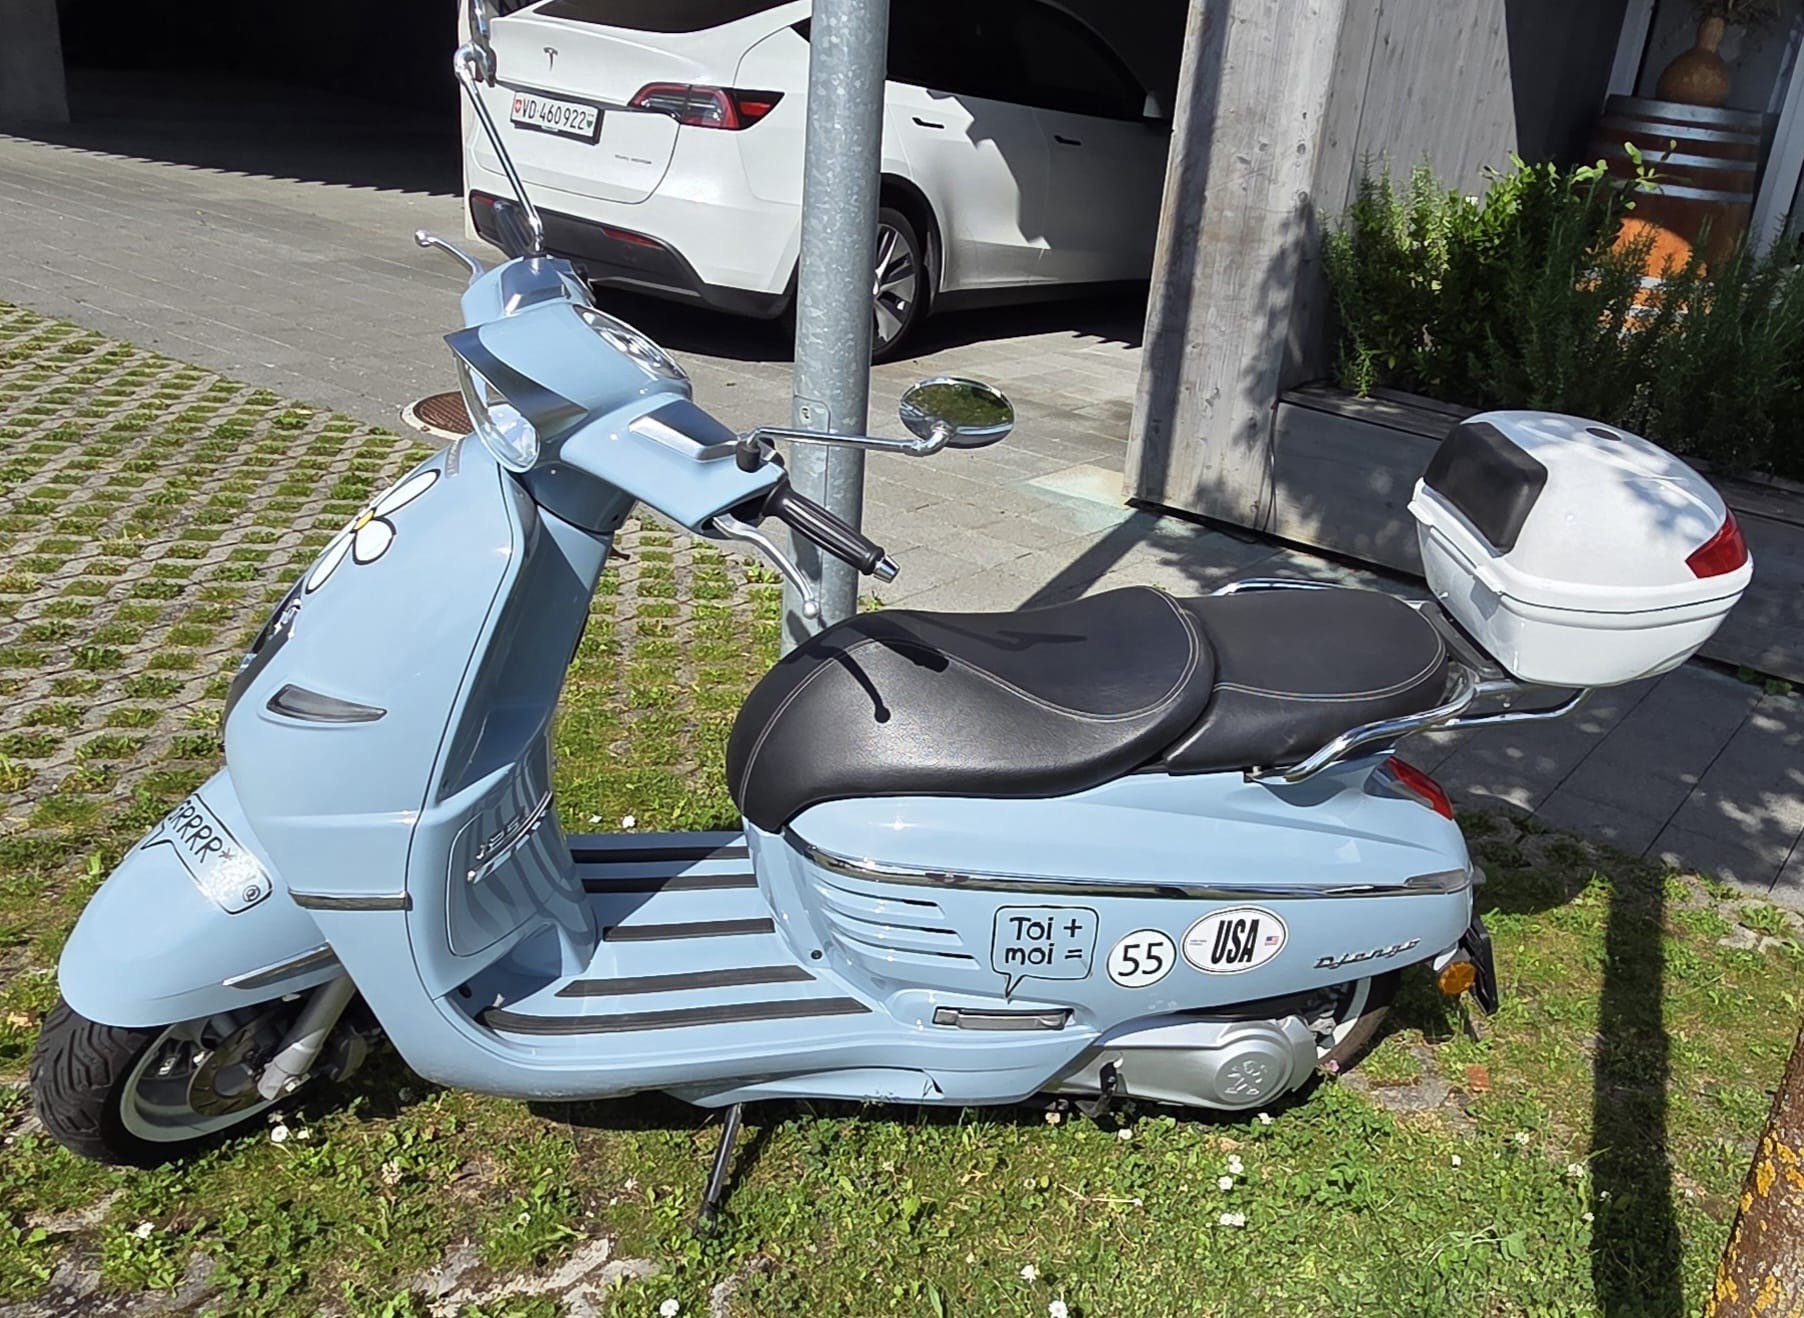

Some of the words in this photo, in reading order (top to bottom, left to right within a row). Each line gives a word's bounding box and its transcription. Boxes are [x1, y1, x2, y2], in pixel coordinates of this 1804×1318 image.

[1009, 916, 1054, 941] Toi
[1210, 918, 1260, 965] USA
[1004, 942, 1055, 966] moi
[1118, 941, 1164, 977] 55
